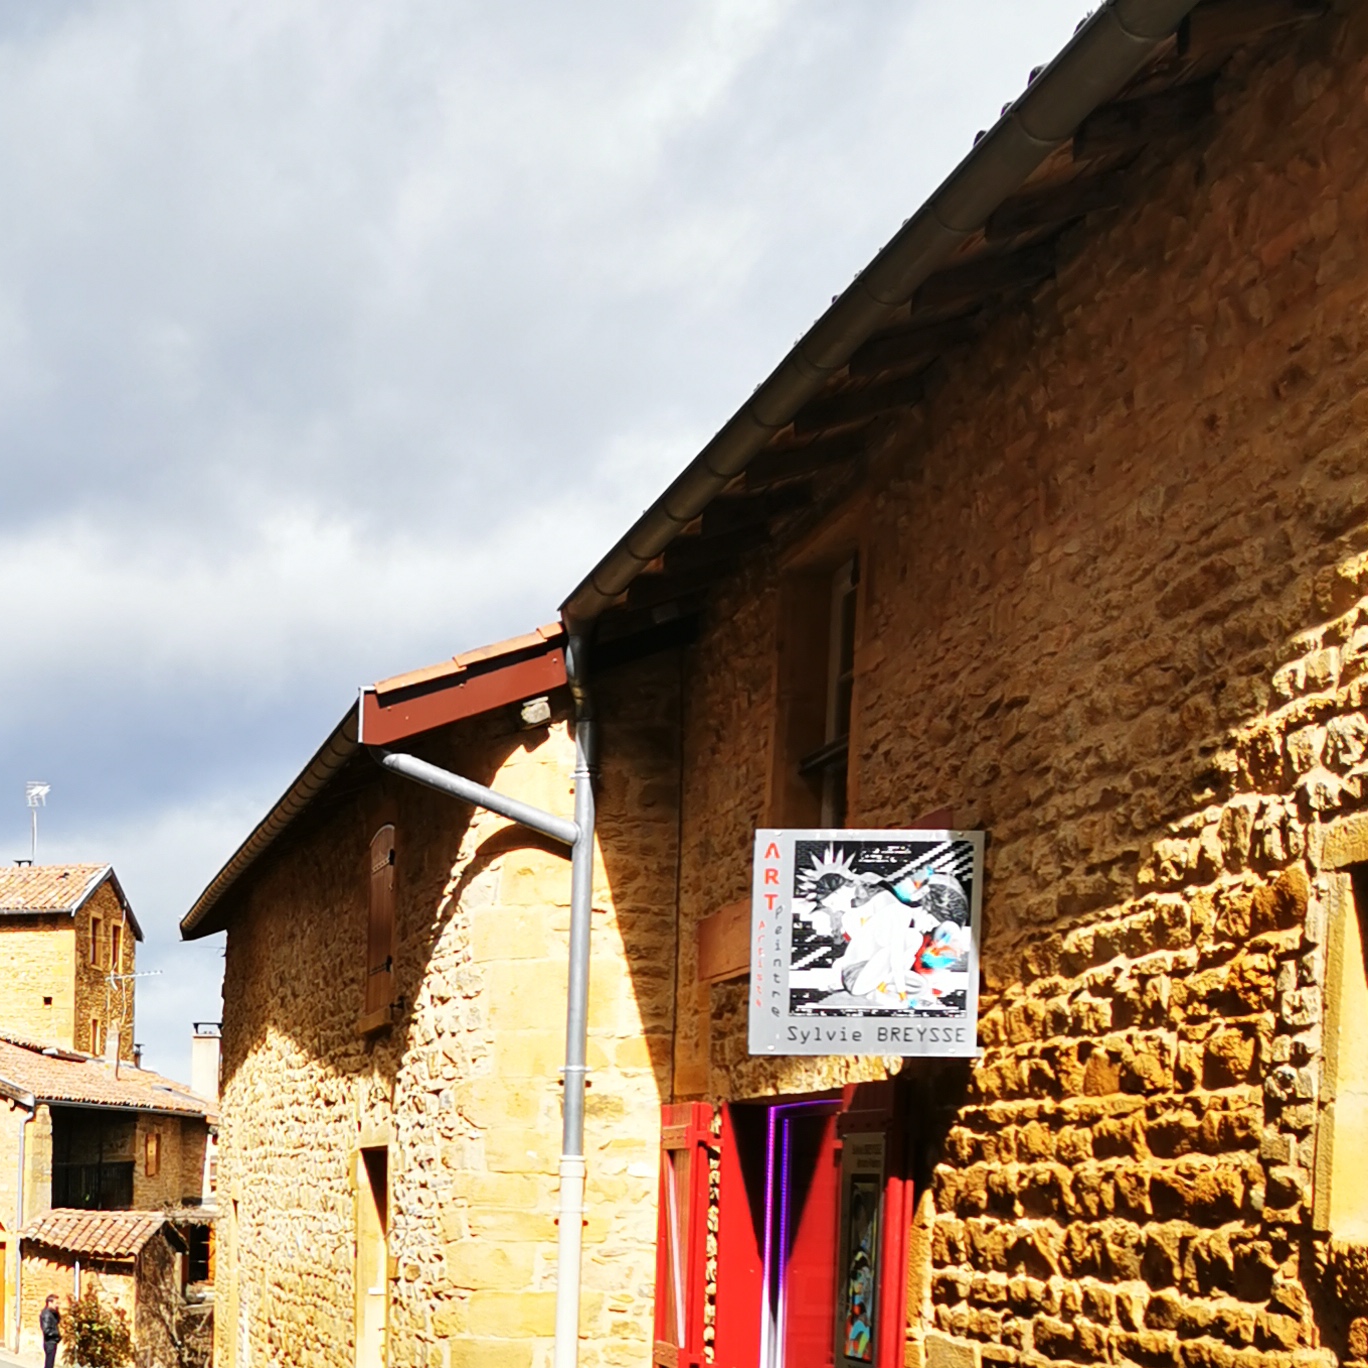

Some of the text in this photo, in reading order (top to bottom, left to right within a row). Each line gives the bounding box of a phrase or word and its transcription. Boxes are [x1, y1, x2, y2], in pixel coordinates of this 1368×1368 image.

[764, 842, 780, 910] ART
[787, 1026, 966, 1045] Sylvie BREYSSE
